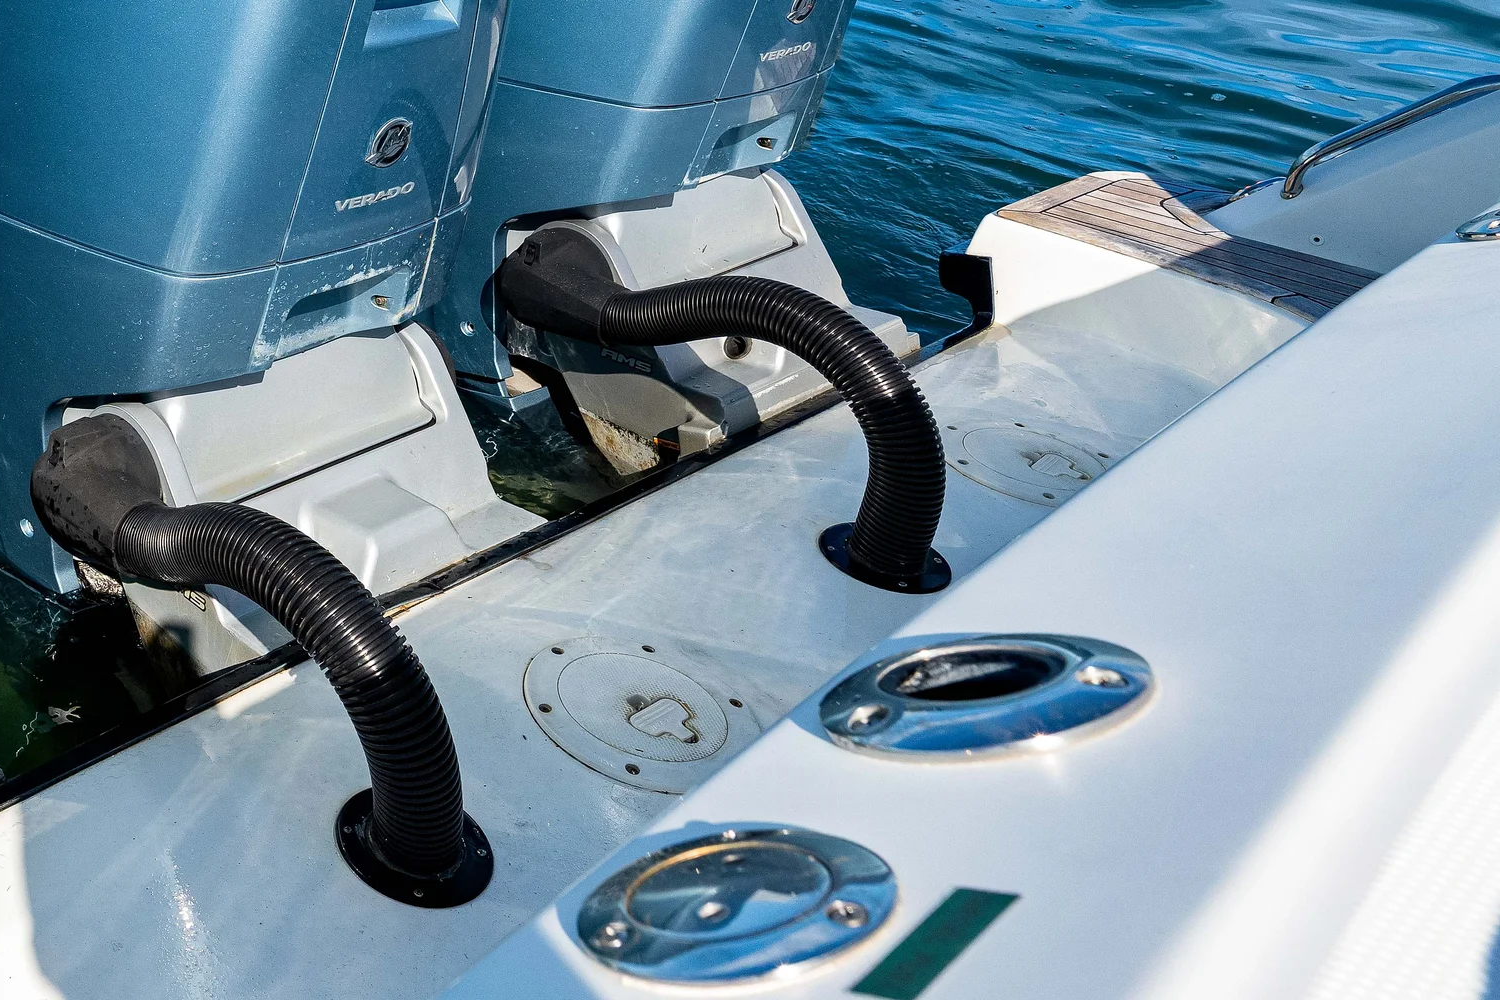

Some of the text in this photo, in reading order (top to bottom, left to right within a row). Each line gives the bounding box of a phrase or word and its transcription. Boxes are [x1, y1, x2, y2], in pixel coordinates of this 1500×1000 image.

[760, 41, 812, 61] VERADO
[334, 181, 415, 211] VERADO
[601, 348, 652, 373] AMS
